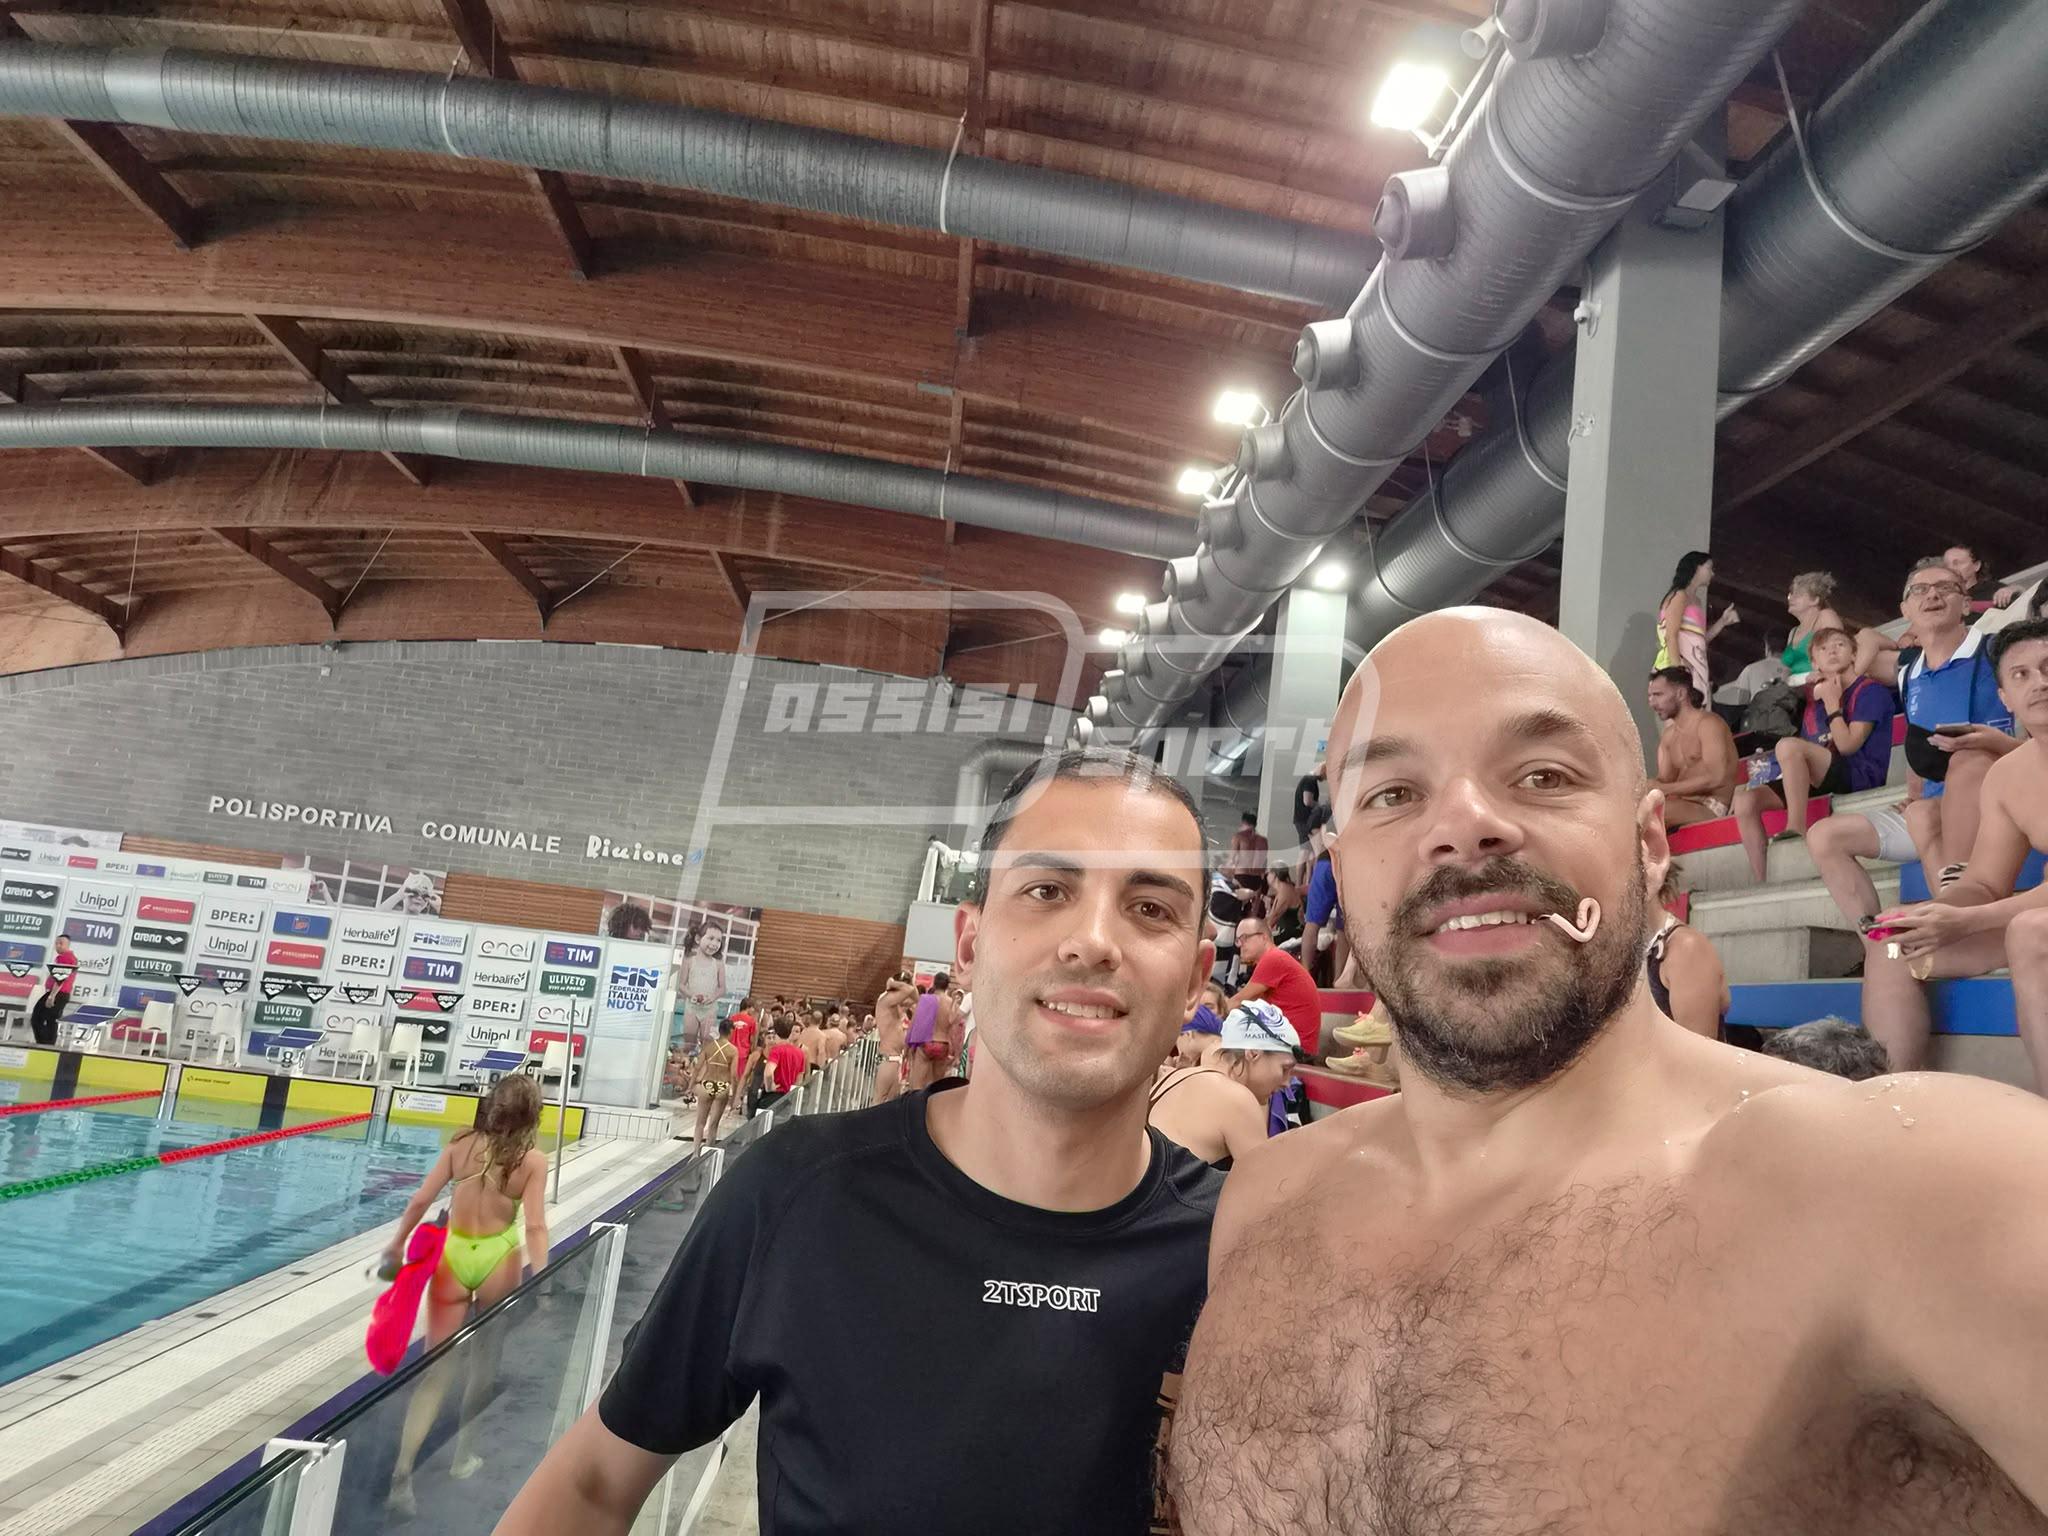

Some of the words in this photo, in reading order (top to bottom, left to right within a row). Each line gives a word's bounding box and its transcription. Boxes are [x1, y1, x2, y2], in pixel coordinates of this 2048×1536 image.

[208, 795, 393, 834] POLISPORTIVA
[421, 821, 562, 854] COMUNALE
[586, 834, 685, 866] Riccione
[249, 878, 264, 887] TIM
[4, 886, 33, 897] arena
[80, 891, 119, 910] Unipol
[4, 914, 43, 926] ULIVETO
[86, 924, 113, 939] TIM
[133, 932, 162, 943] arena
[343, 927, 390, 941] Herbalife
[208, 936, 248, 955] Unipol
[481, 940, 529, 957] enel
[567, 948, 594, 962] TIM
[134, 960, 172, 972] ULIVETO
[427, 963, 455, 978] TIM
[474, 972, 521, 986] Herbalife
[549, 975, 586, 986] ULIVETO
[611, 965, 660, 989] FIN
[264, 1005, 302, 1017] ULIVETO
[983, 1280, 1100, 1312] 2TSPORT
